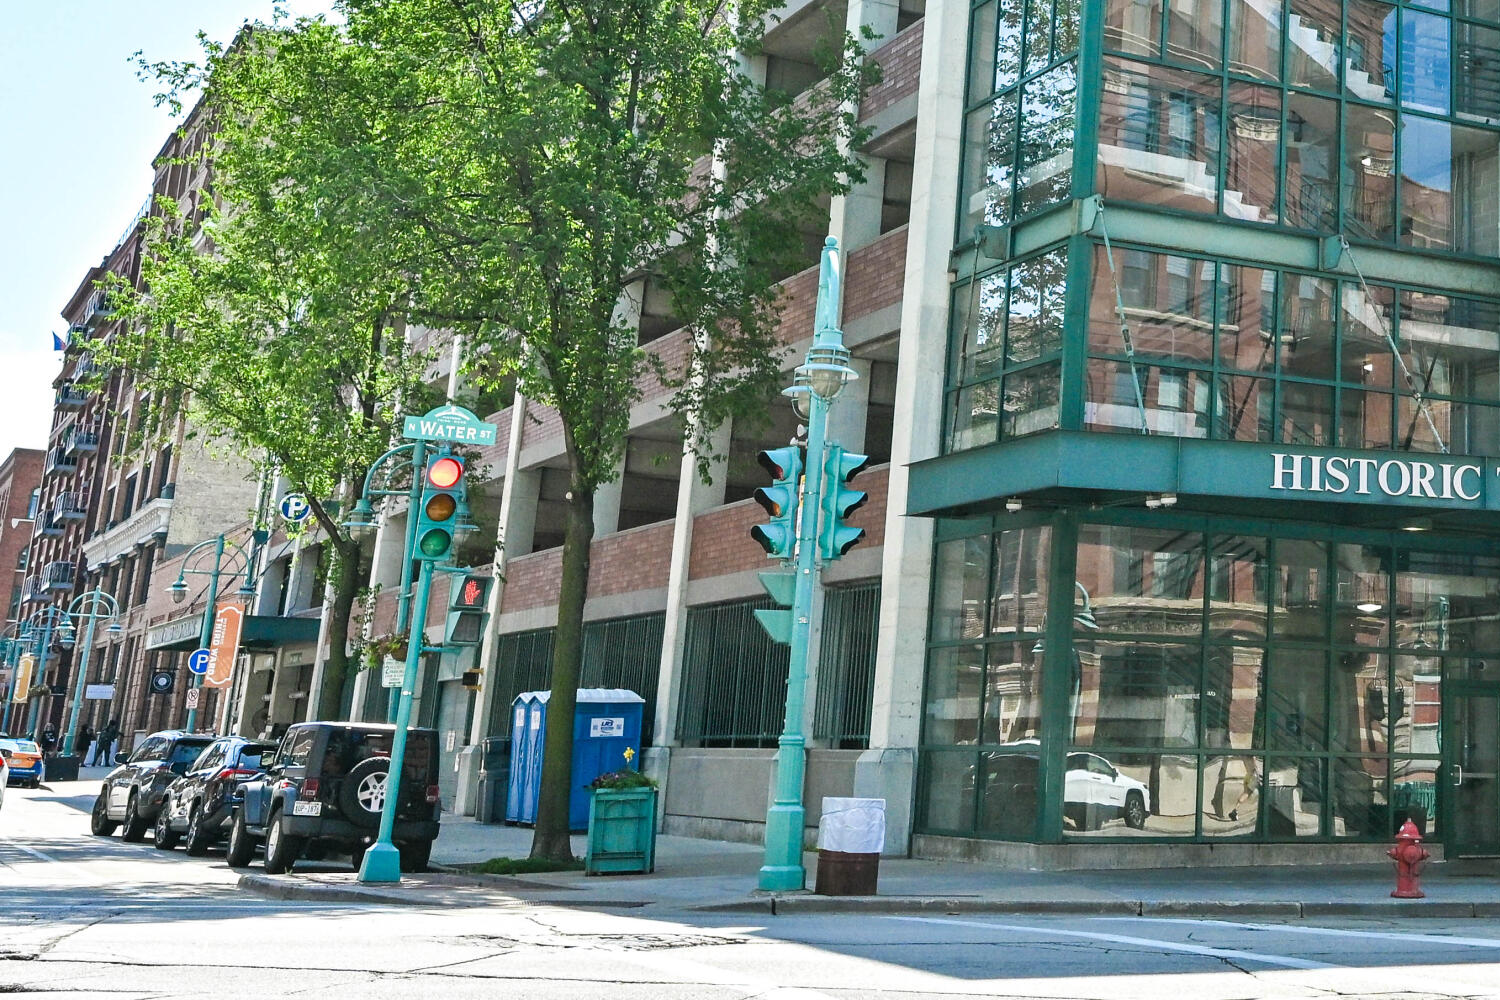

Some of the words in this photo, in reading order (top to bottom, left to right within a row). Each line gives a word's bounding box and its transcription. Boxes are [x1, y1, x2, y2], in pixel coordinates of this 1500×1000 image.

[408, 423, 416, 432] N
[420, 420, 477, 440] WATER
[479, 430, 492, 439] ST
[1269, 452, 1481, 501] HISTORIC
[288, 497, 306, 518] P
[212, 617, 224, 646] THIRD
[195, 654, 209, 670] P
[207, 648, 219, 676] WARD
